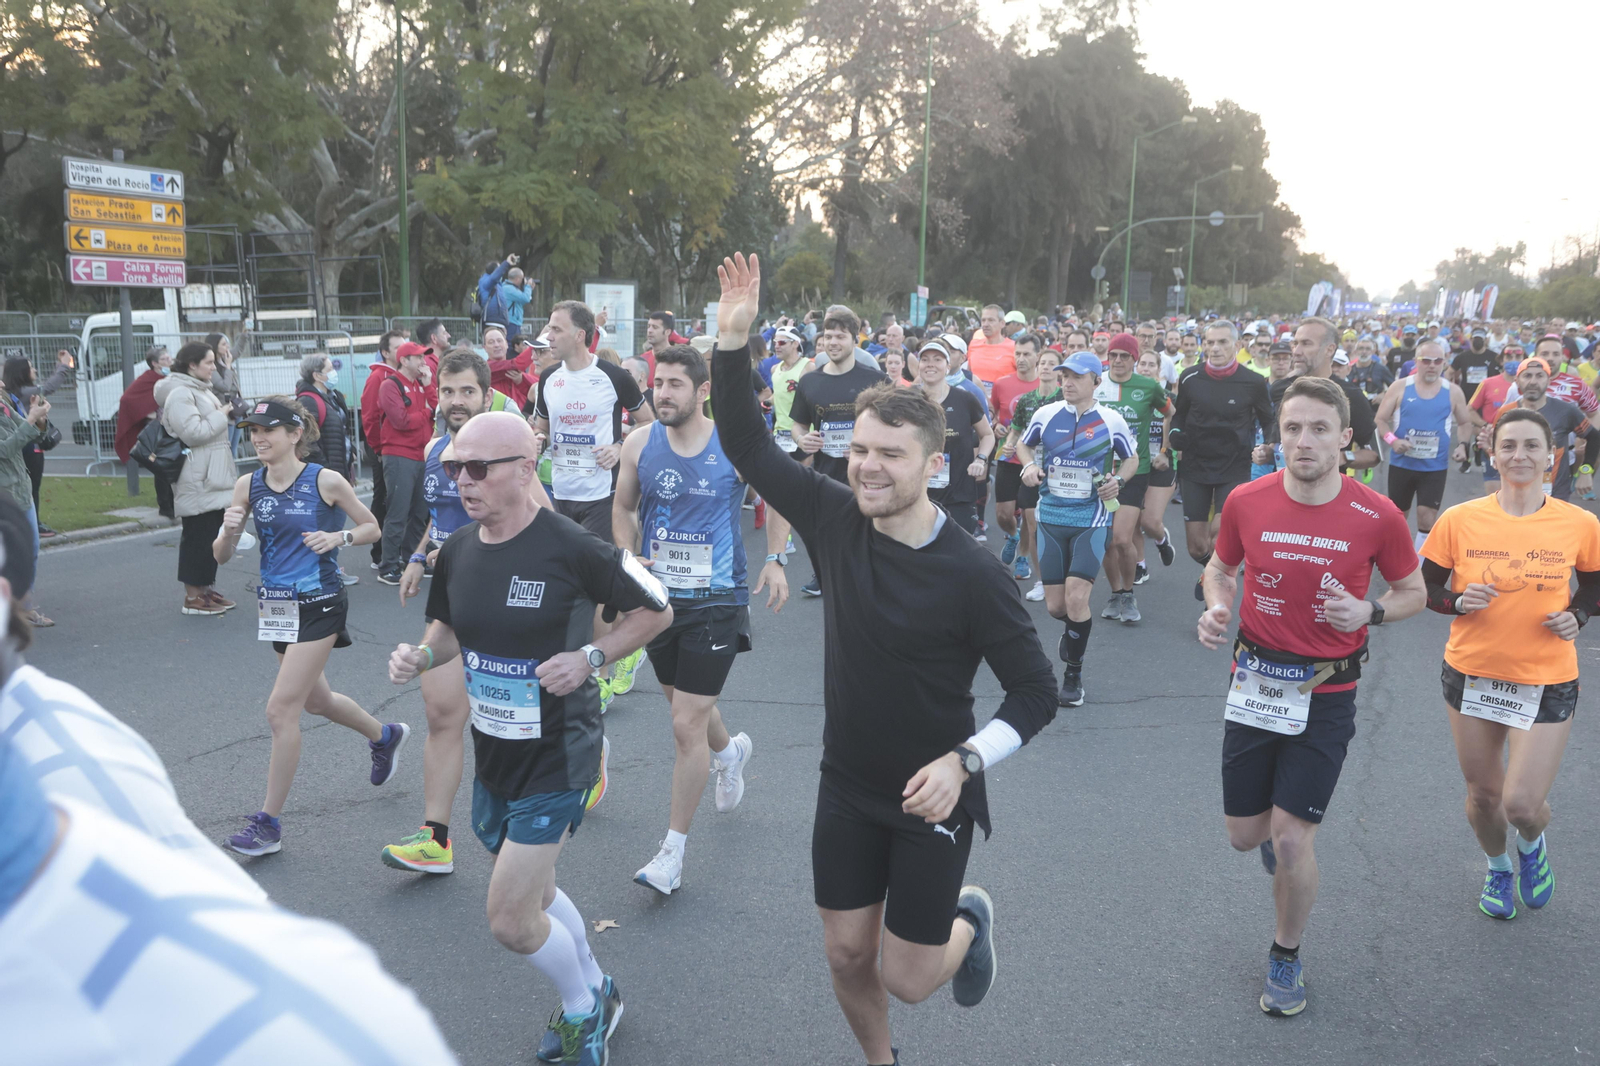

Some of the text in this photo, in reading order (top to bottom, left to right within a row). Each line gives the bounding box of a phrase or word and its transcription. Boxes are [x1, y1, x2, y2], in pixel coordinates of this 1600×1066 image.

[70, 163, 102, 174] hospital
[71, 172, 102, 185] Virgen
[106, 177, 121, 186] del
[108, 199, 135, 210] Prado
[73, 207, 91, 217] San
[107, 241, 182, 254] Plaza de Armas
[123, 262, 183, 274] Caixa Forum
[122, 272, 183, 284] Torre Sevilla
[286, 345, 298, 353] AMS
[566, 401, 586, 411] edp
[1350, 501, 1375, 516] CRAFT
[669, 531, 706, 542] ZURICH
[1260, 531, 1351, 552] RUNNING BREAK
[668, 549, 690, 561] 9013
[1273, 551, 1333, 566] GEOFFREY
[1540, 549, 1563, 557] Divina
[1540, 555, 1566, 564] Pastora
[666, 564, 691, 574] PULIDO
[268, 590, 293, 598] ZURICH
[271, 607, 285, 615] 8535
[481, 659, 527, 676] ZURICH
[1260, 664, 1304, 678] ZURICH
[479, 684, 511, 701] 10255
[1258, 684, 1283, 699] 9506
[1491, 681, 1518, 695] 9176
[1244, 698, 1290, 716] GEOFFREY
[1480, 694, 1523, 711] CRISAM27
[478, 703, 515, 720] MAURICE
